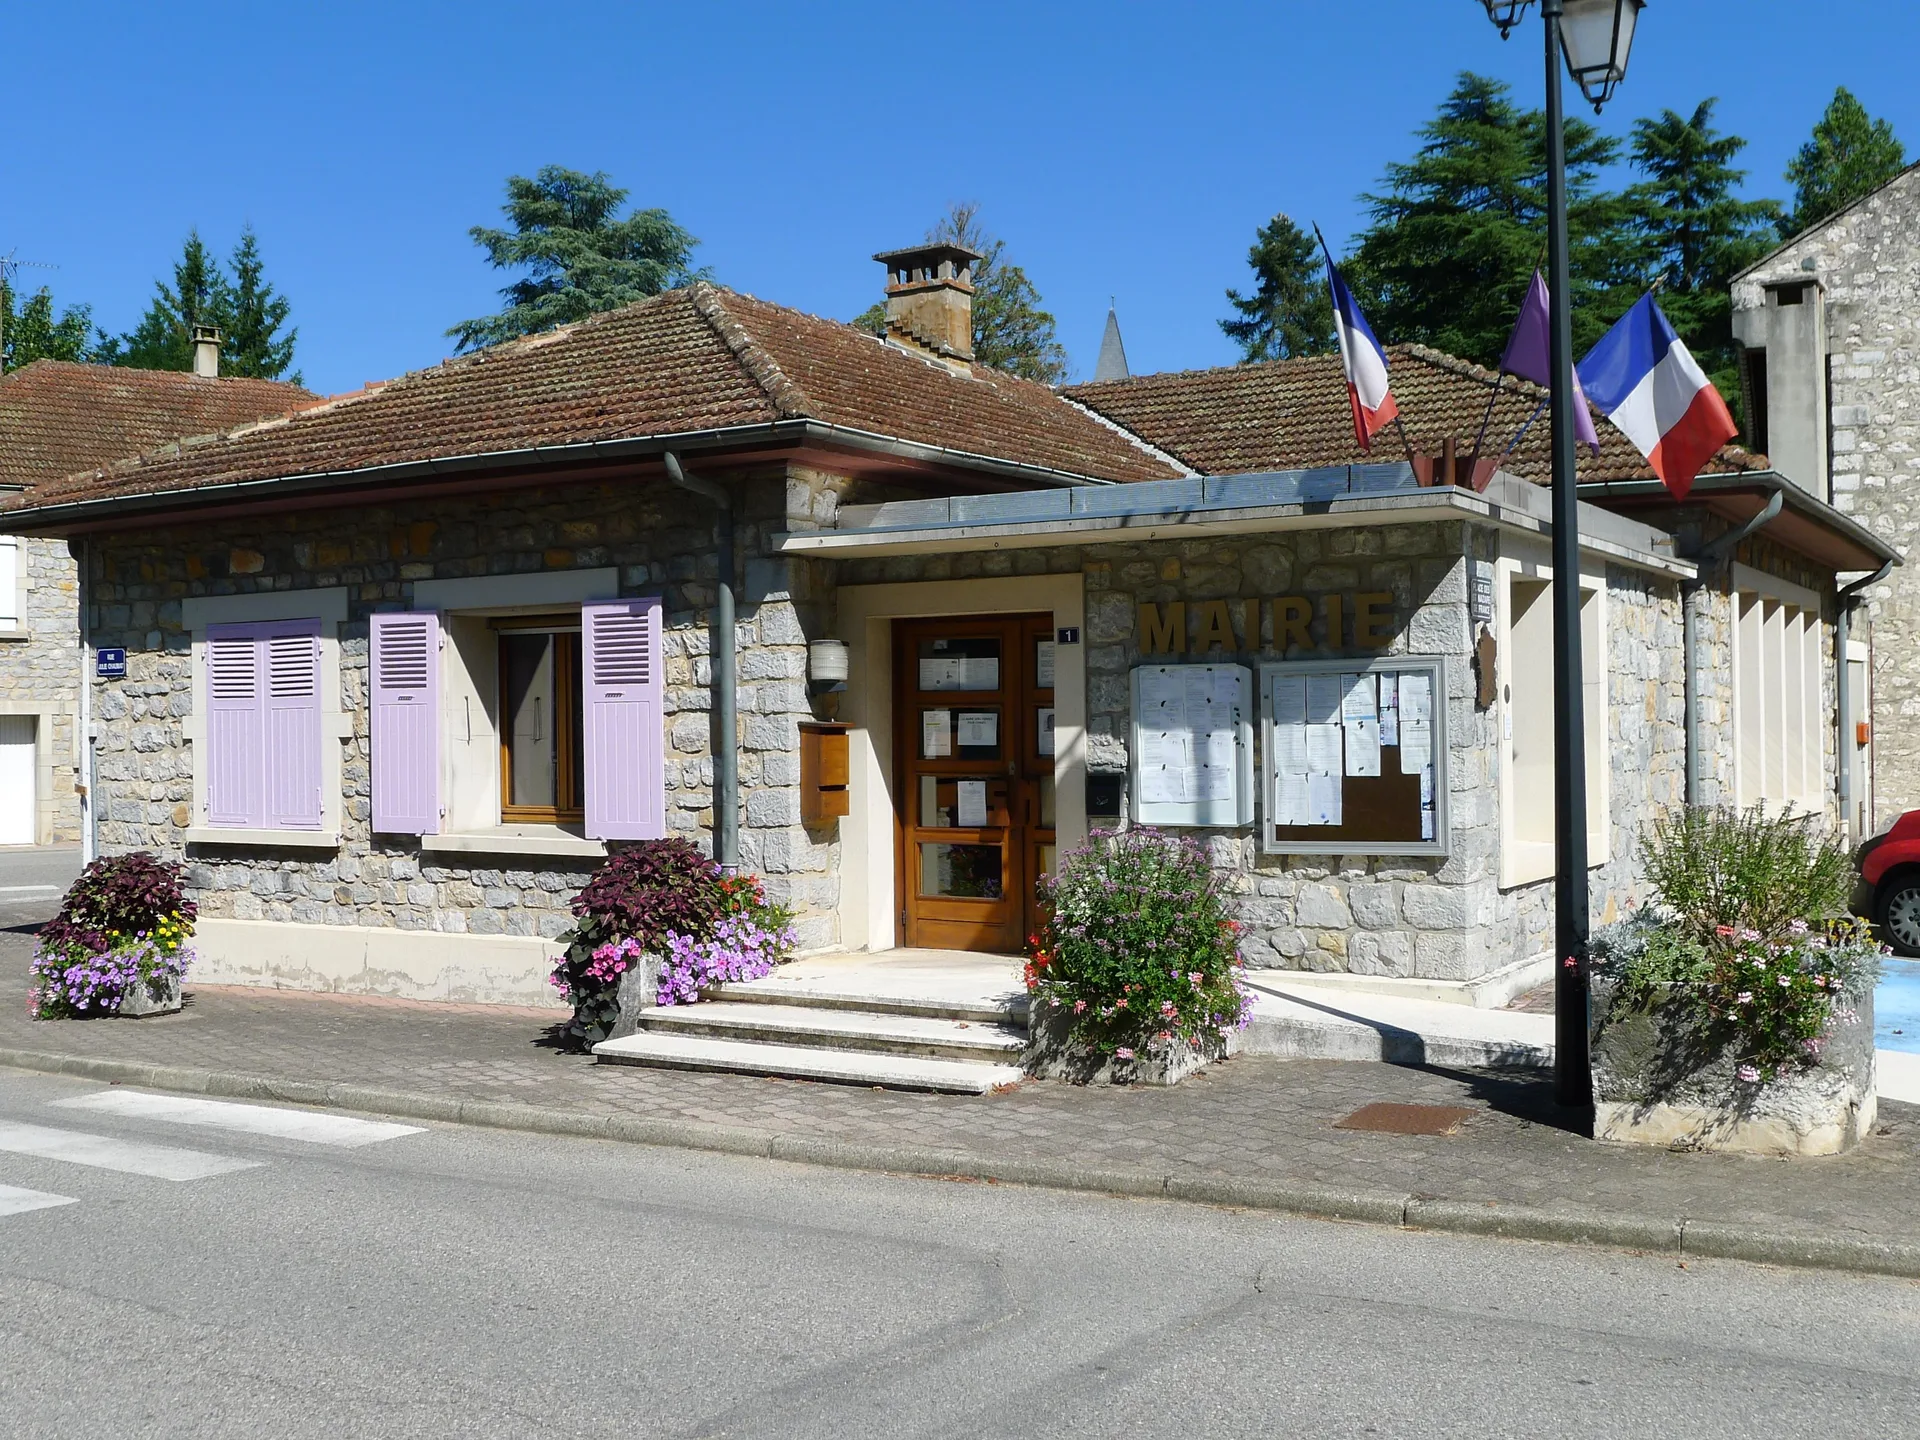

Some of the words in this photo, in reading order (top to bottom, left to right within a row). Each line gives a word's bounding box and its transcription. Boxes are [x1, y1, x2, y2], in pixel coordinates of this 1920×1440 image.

[1478, 604, 1490, 614] FRANCE
[1139, 592, 1393, 655] MAIRIE
[1065, 630, 1071, 641] 1
